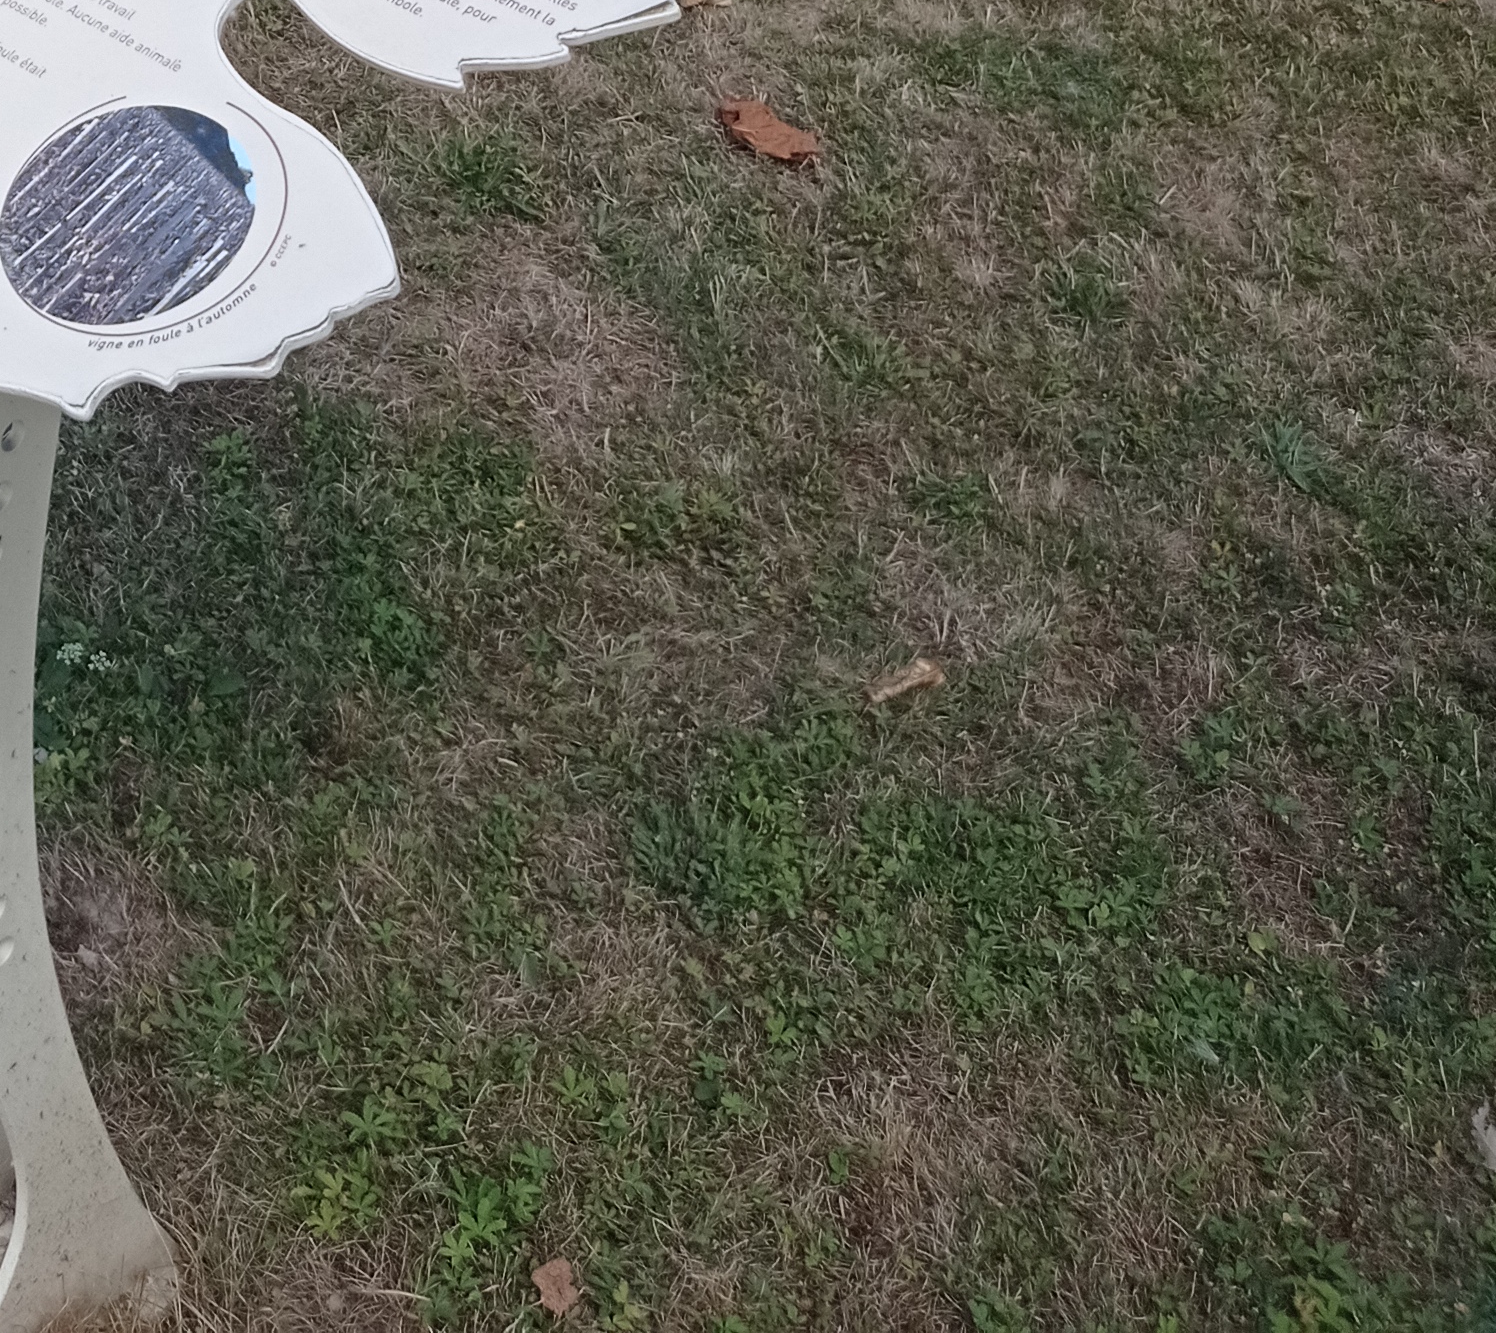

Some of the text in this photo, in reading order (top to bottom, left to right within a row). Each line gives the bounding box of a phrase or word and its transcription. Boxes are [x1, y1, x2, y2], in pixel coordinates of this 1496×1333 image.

[88, 338, 124, 352] vigne
[127, 338, 145, 350] en
[148, 329, 182, 346] foule
[186, 323, 195, 335] à
